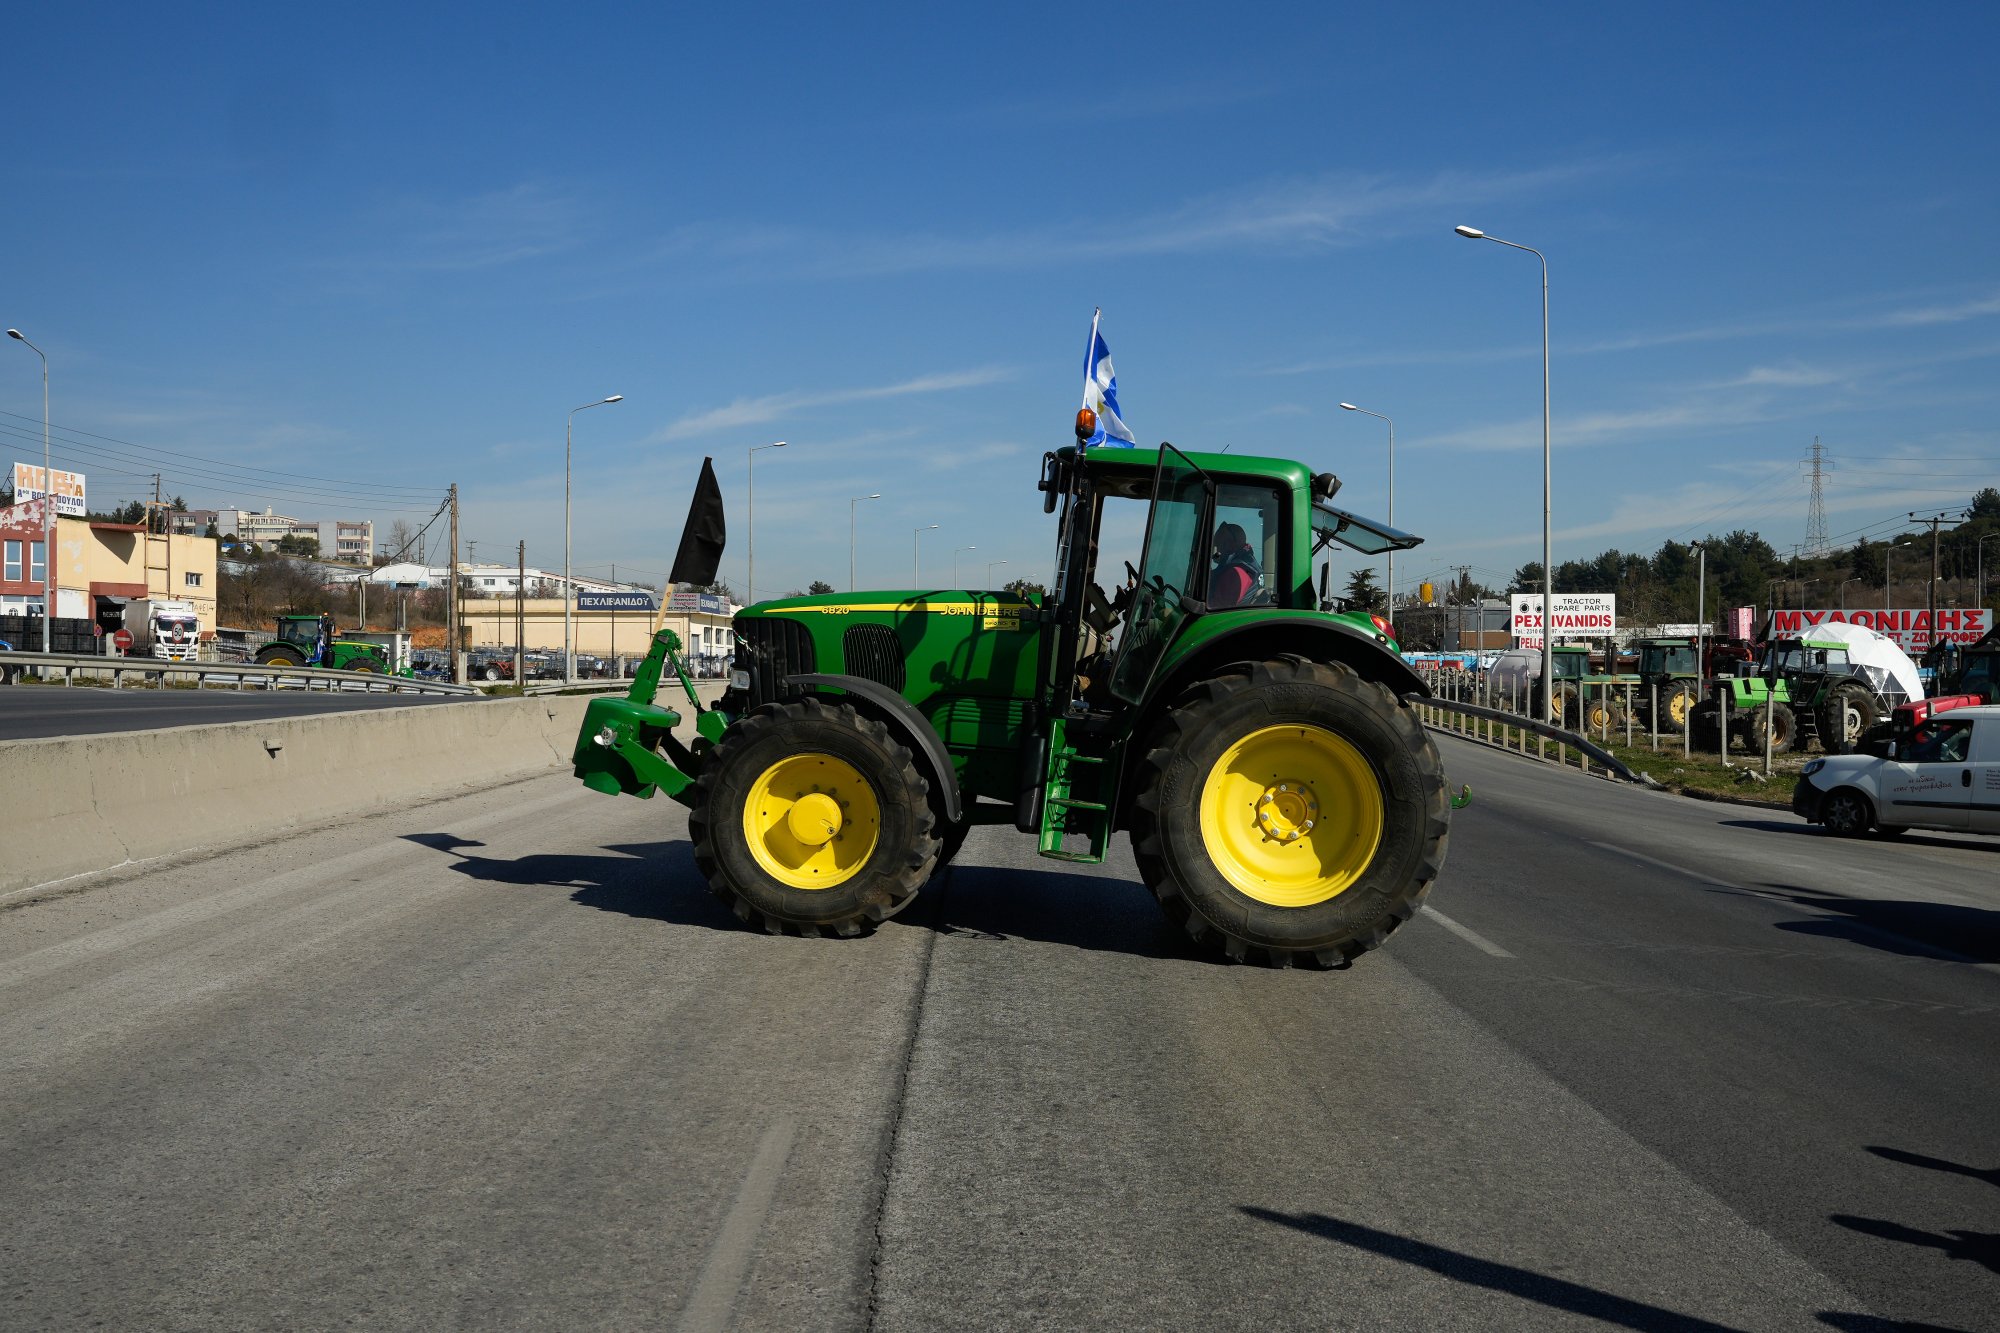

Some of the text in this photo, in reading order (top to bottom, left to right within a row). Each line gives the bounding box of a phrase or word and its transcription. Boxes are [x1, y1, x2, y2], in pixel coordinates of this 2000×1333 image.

[822, 606, 850, 614] 6820
[940, 604, 1020, 616] JOHN DEERE
[1514, 614, 1612, 628] PEXIVANIDIS
[174, 627, 182, 636] 50
